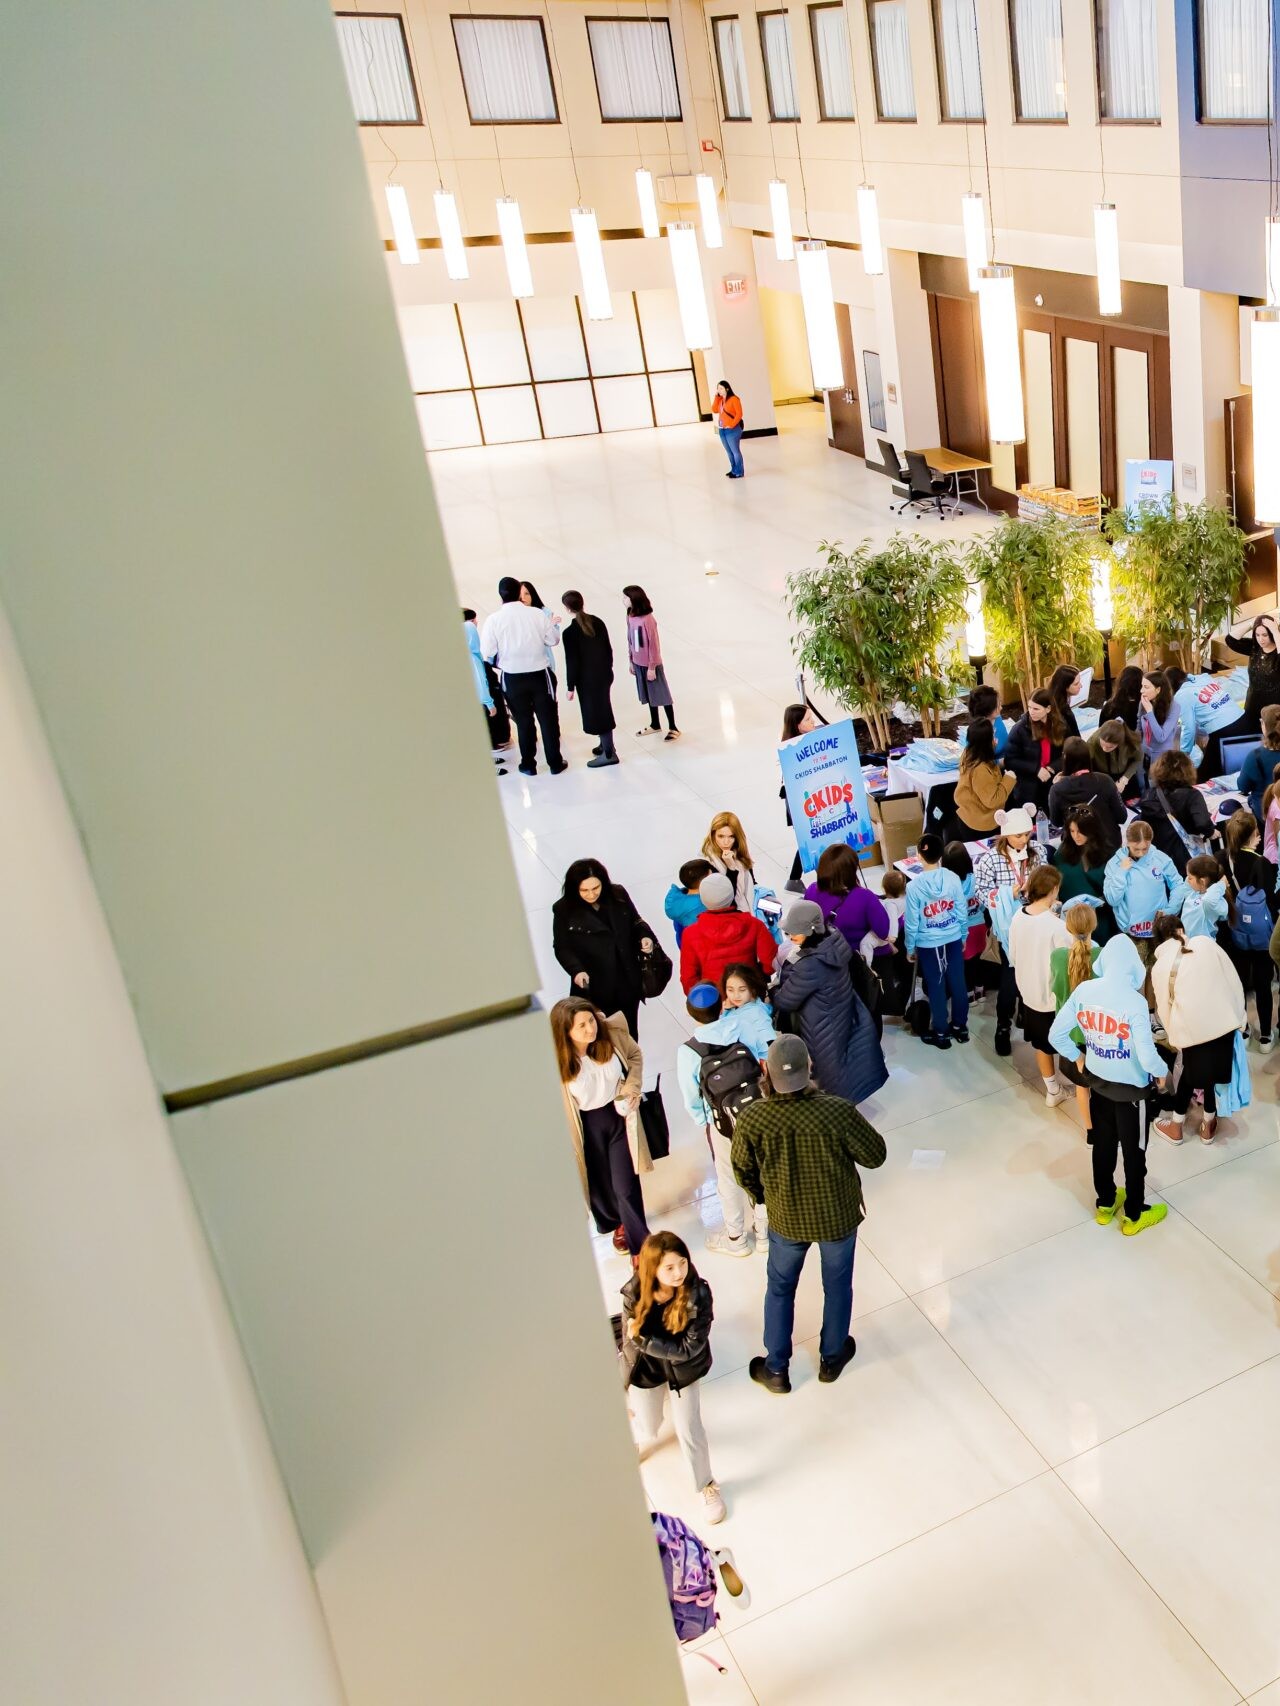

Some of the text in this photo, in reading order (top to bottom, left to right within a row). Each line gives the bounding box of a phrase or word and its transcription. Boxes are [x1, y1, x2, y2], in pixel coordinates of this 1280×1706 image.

[795, 737, 839, 763] WELCOME
[794, 755, 848, 780] CKIDS SHABBATON
[803, 783, 854, 818] CKIDS
[810, 811, 858, 839] SHABBATON
[1130, 921, 1153, 933] CKID
[1076, 1010, 1130, 1041] CKIDS
